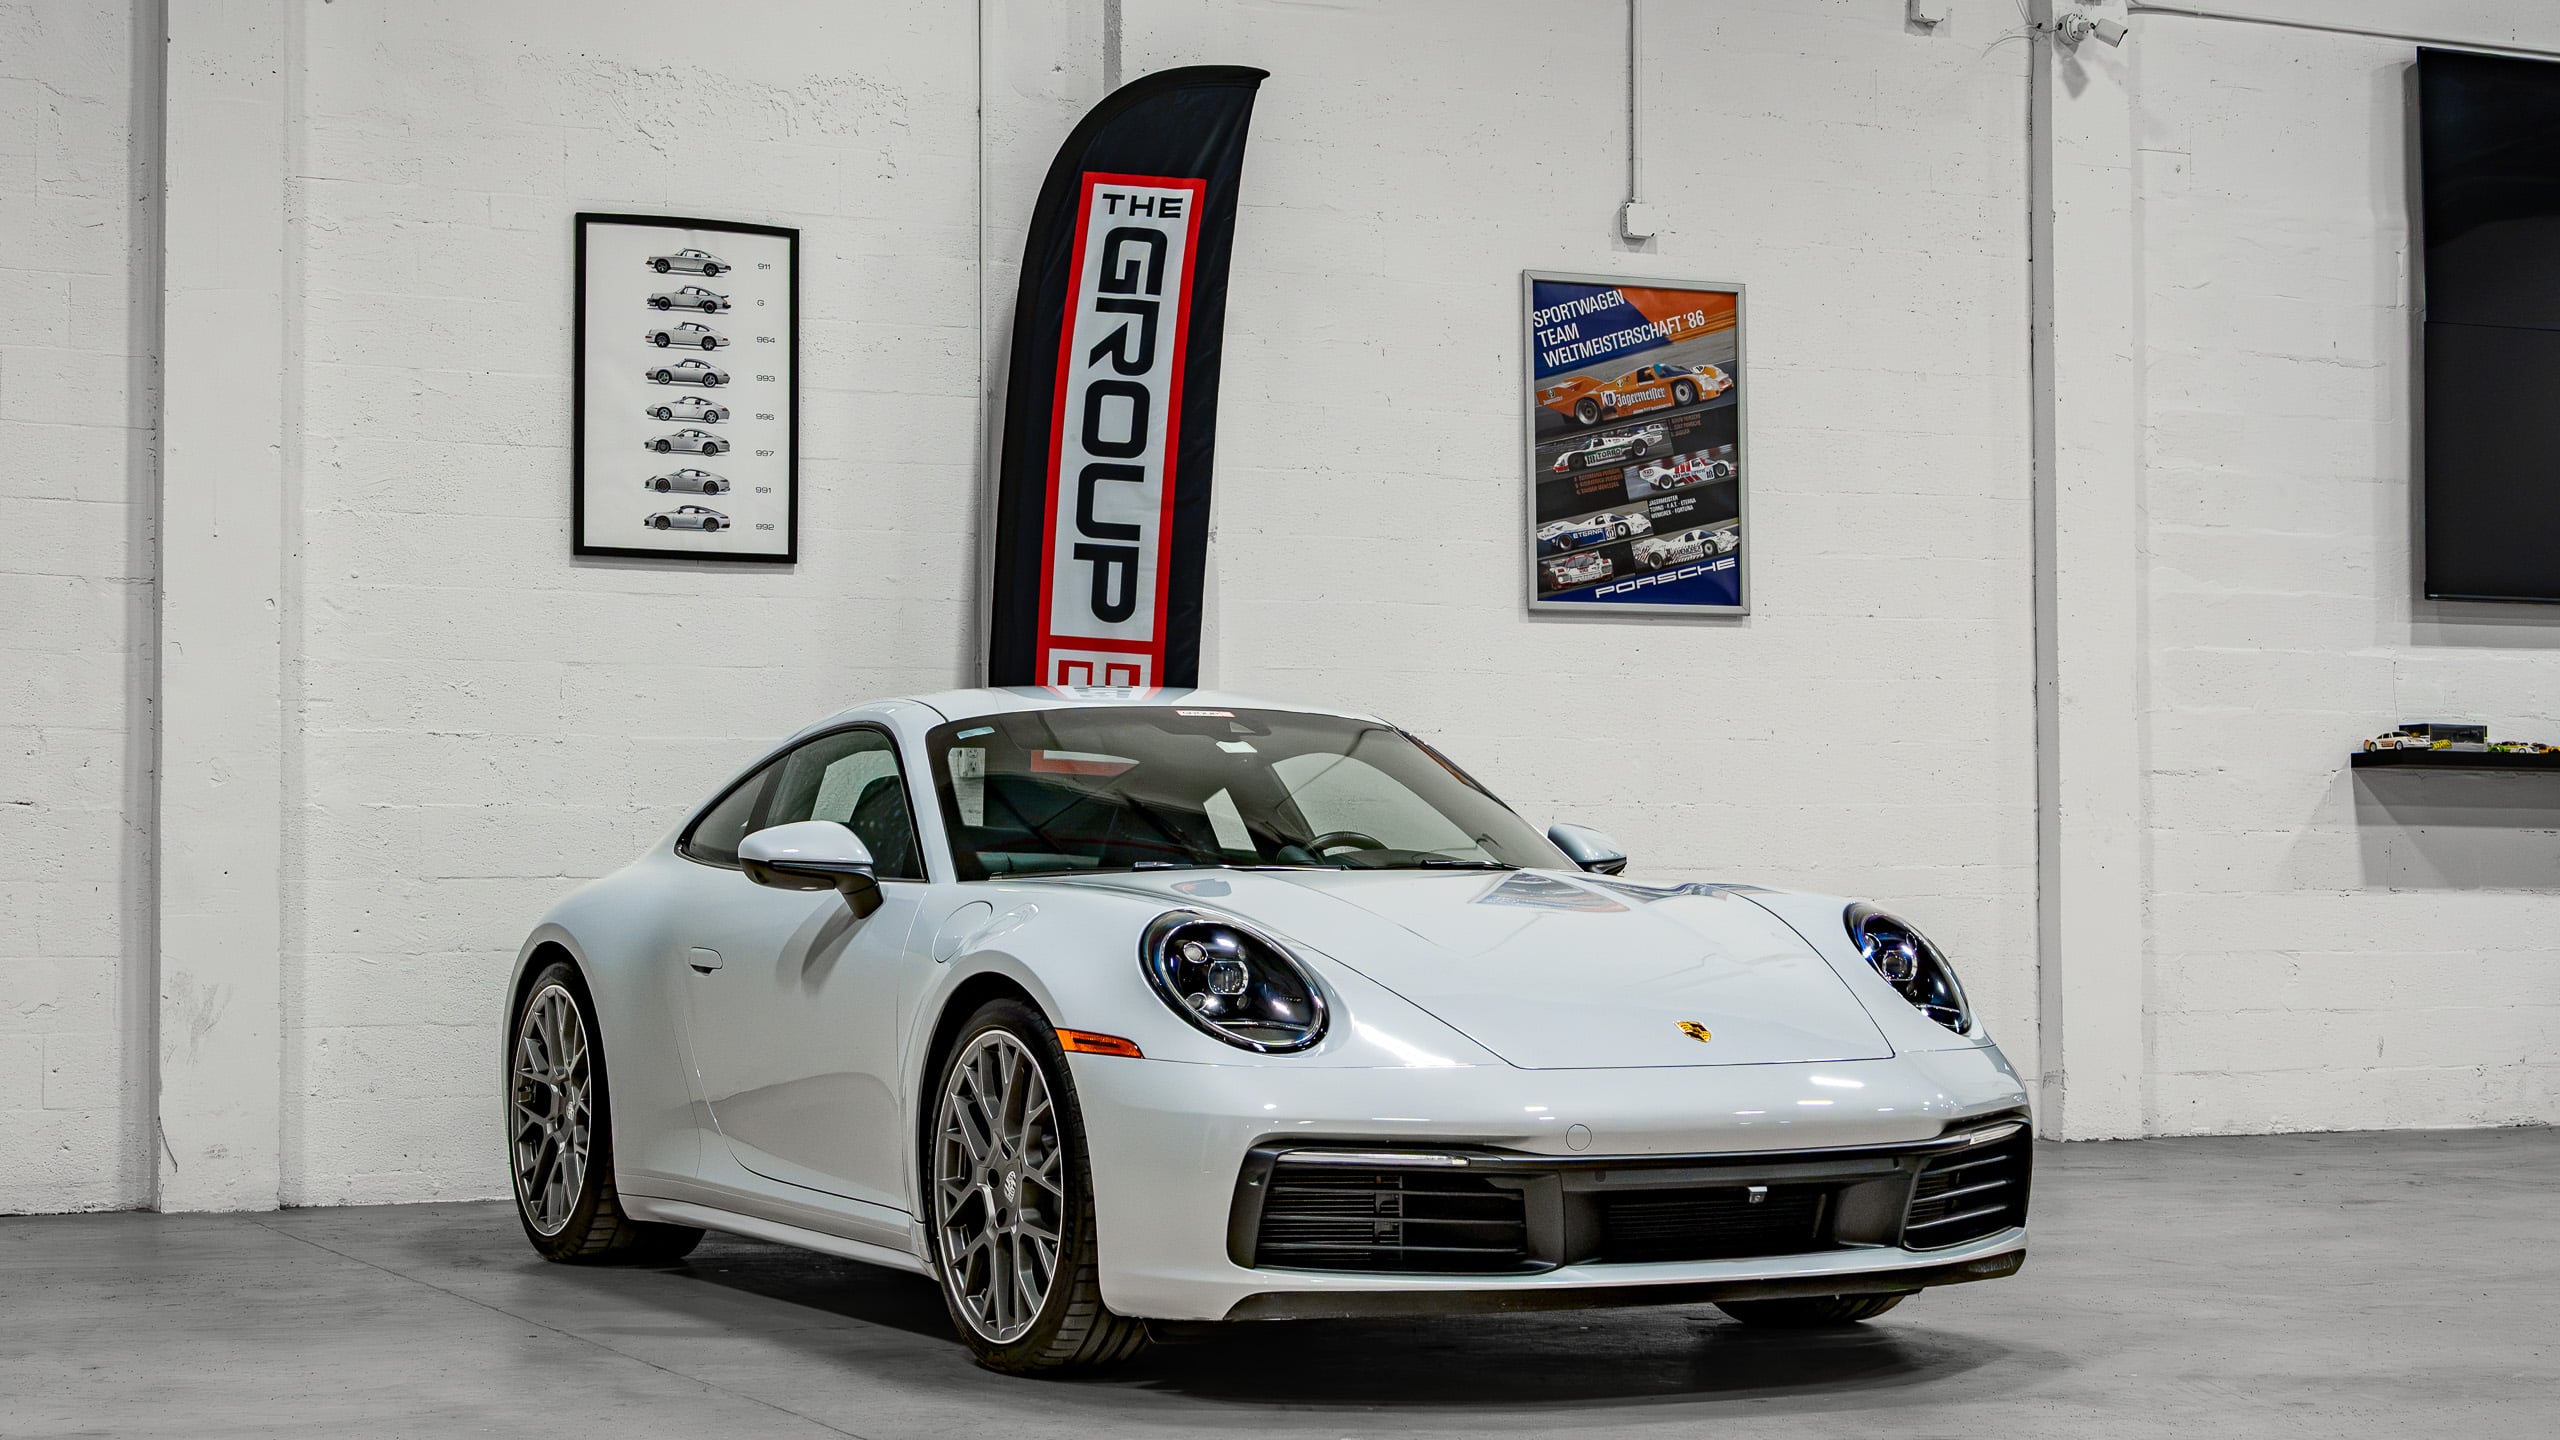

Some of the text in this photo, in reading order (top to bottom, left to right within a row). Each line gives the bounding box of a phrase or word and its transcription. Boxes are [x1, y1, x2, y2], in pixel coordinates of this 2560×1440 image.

[1102, 192, 1184, 219] THE
[757, 262, 771, 271] 911
[757, 299, 765, 307] G
[1533, 289, 1625, 328] SPORTWAGEN
[1537, 322, 1580, 348] TEAM
[756, 336, 776, 344] 964
[1543, 315, 1681, 368] WELTMEISTERSCHAFT
[756, 374, 776, 383] 993
[756, 412, 775, 421] 996
[1073, 225, 1169, 624] GROUP
[756, 449, 775, 457] 997
[755, 486, 772, 494] 991
[756, 523, 775, 531] 992
[1572, 528, 1603, 539] ETERNA
[1595, 557, 1737, 599] PORSCHE
